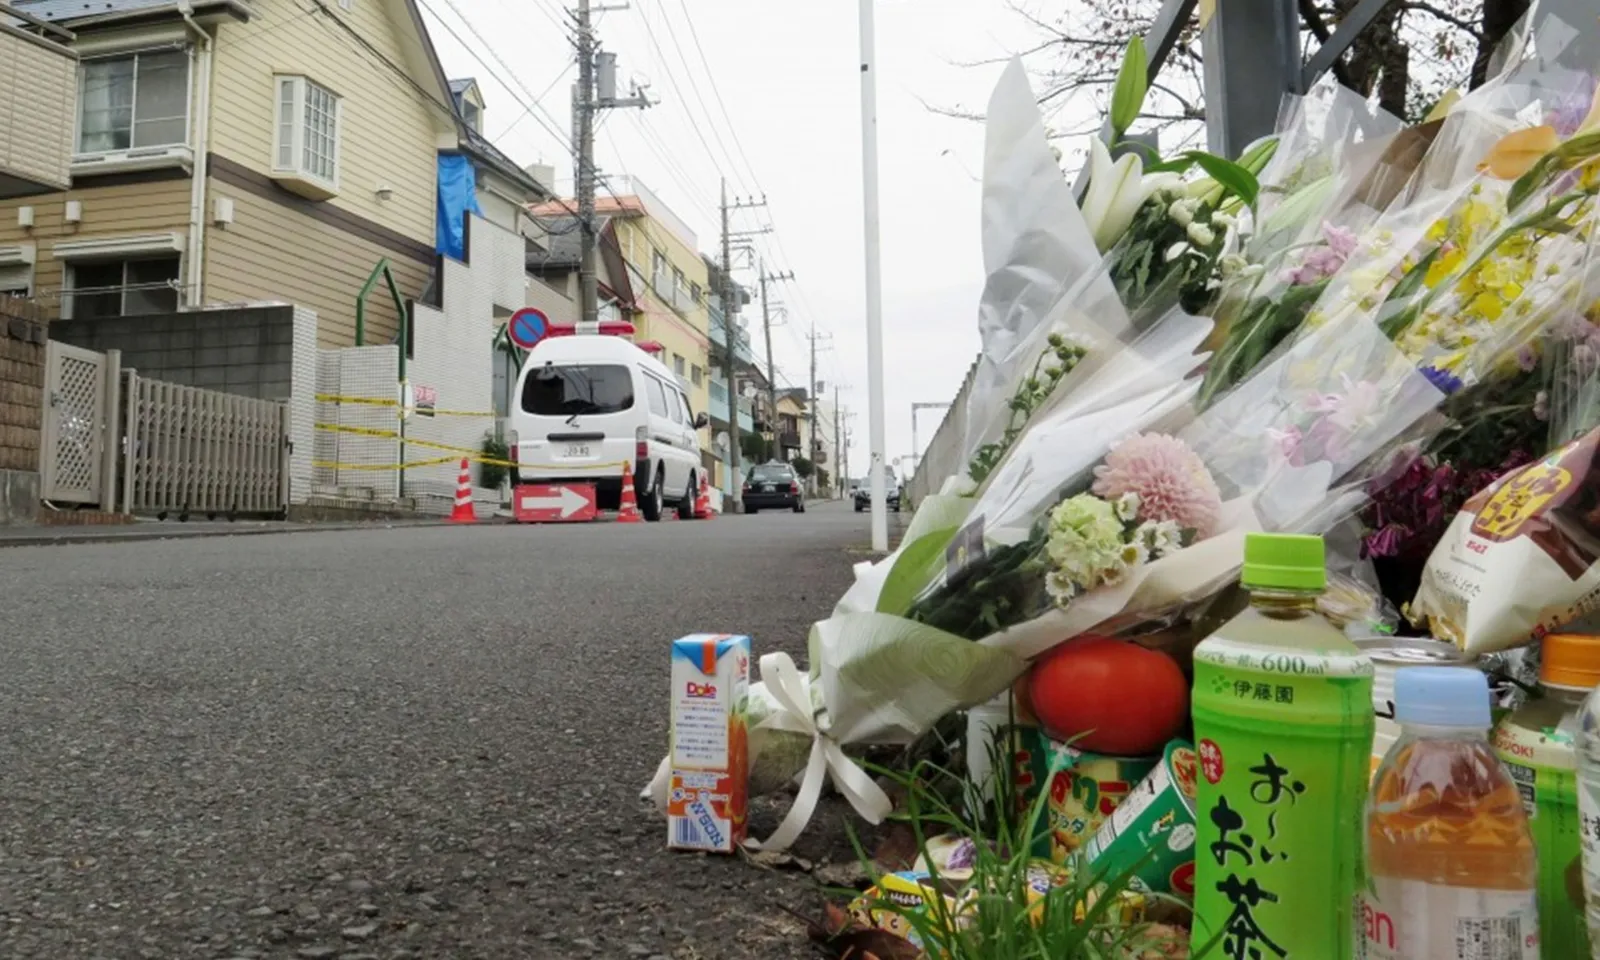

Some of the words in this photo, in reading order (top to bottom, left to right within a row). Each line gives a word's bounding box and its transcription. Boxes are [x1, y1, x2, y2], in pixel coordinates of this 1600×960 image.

[687, 682, 717, 696] Dole
[1234, 680, 1294, 704] 伊藤園
